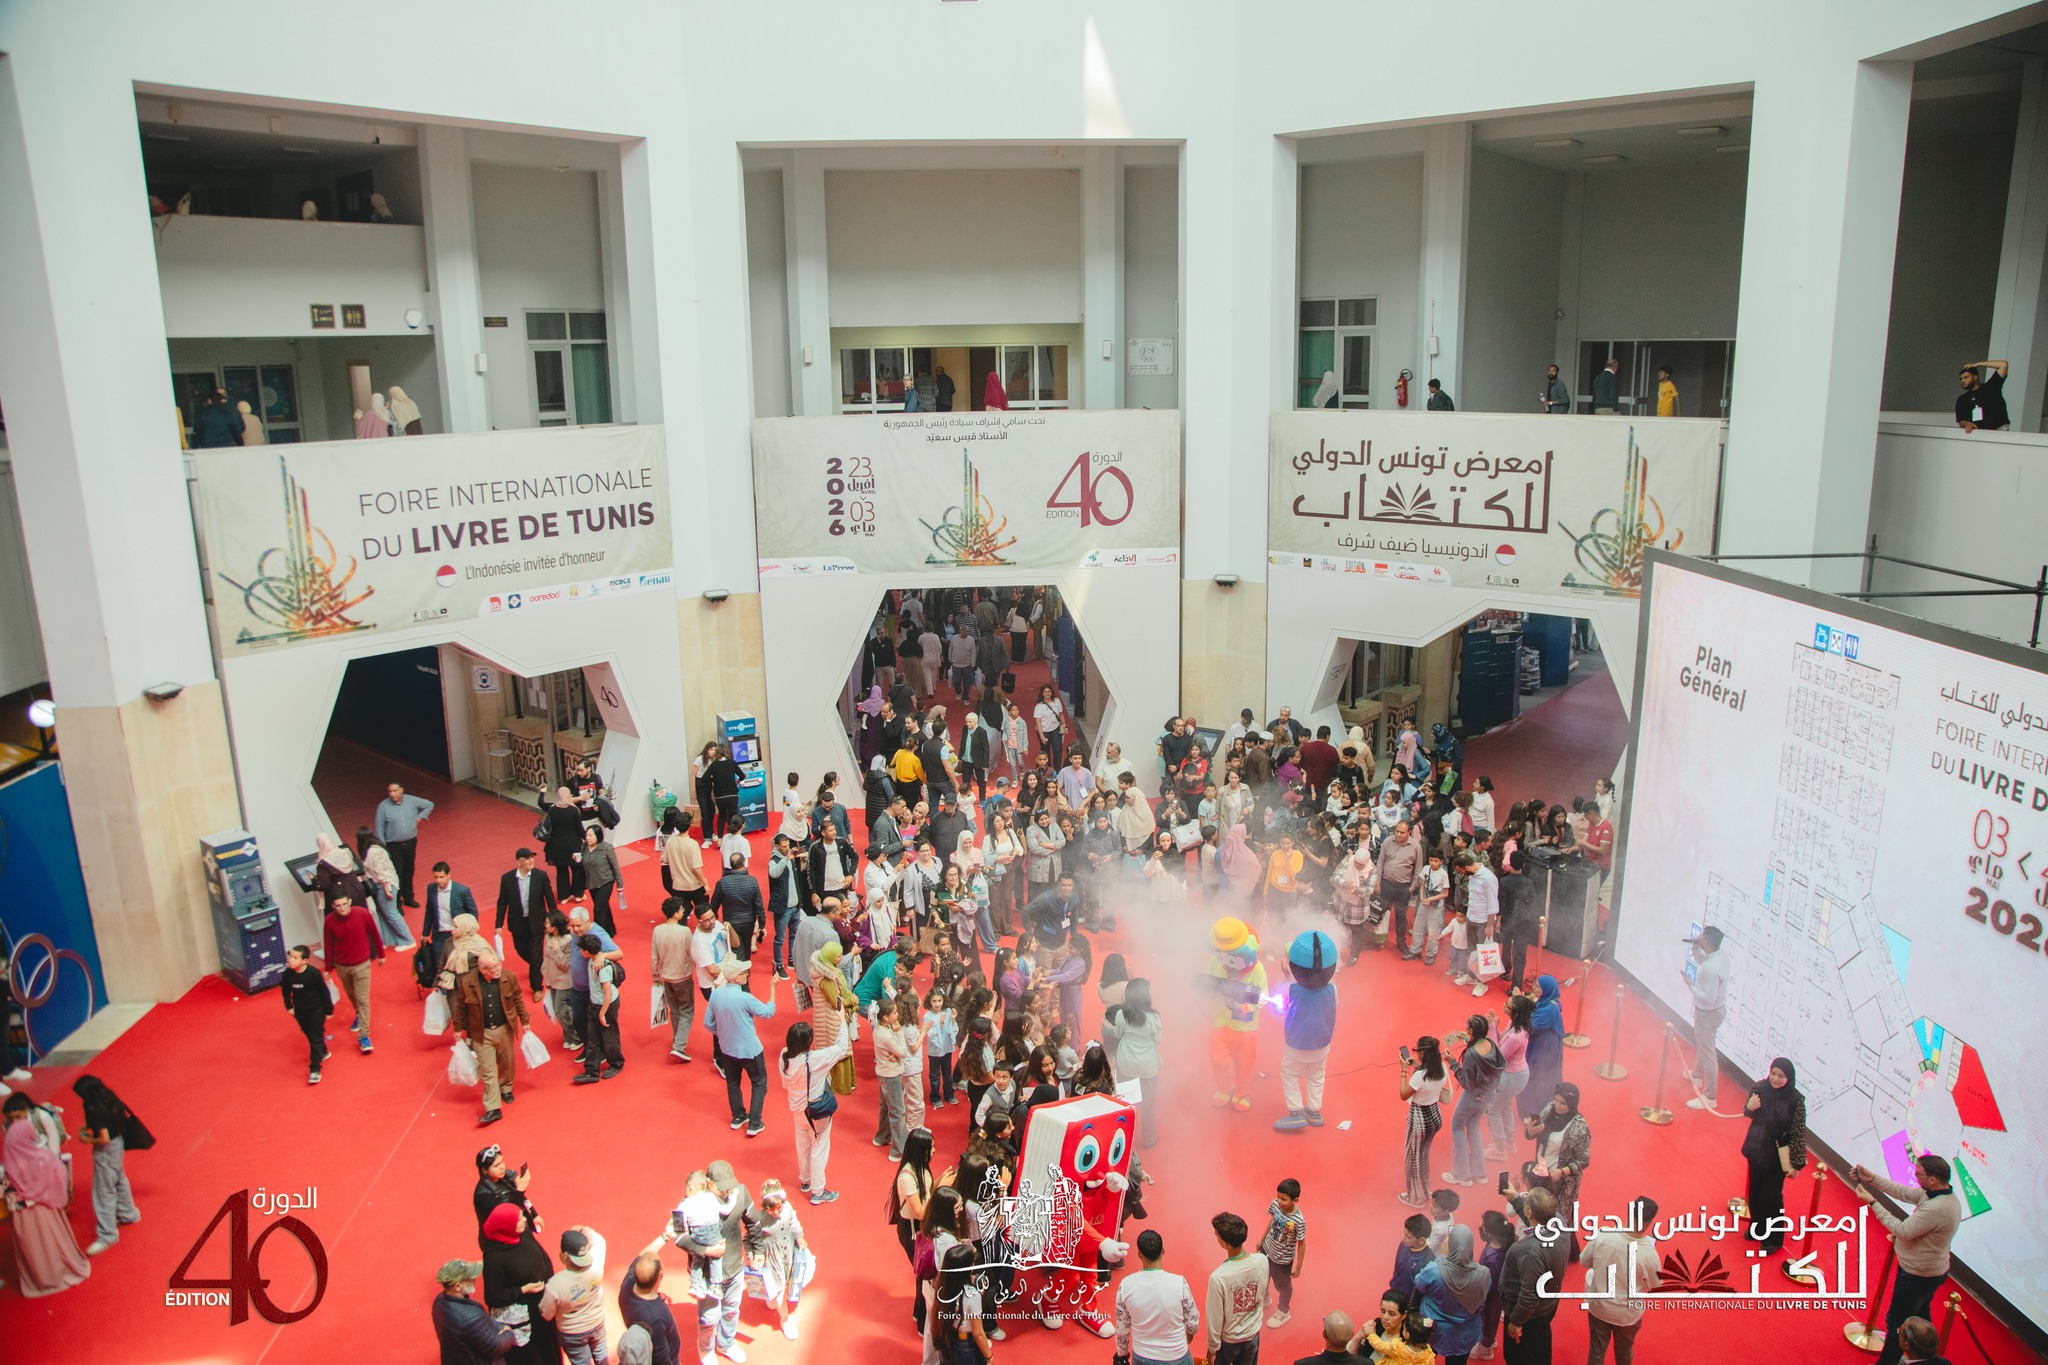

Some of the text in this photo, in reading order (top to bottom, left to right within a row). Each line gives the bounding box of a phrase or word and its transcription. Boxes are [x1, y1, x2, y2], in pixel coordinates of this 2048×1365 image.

[883, 418, 924, 430] الجمهورية
[925, 418, 948, 429] رئيس
[949, 418, 974, 427] سيادة
[975, 417, 1001, 427] إشراف
[1002, 418, 1027, 428] سامي
[953, 433, 977, 443] قيس
[978, 430, 1008, 440] الأستاذ
[848, 456, 873, 478] 23
[1092, 451, 1122, 465] الدورة
[1292, 438, 1543, 479] معرض تونس الدولي
[359, 467, 653, 517] FOIRE INTERNATIONALE
[1046, 451, 1134, 528] 40
[849, 501, 876, 522] 03
[1046, 508, 1080, 519] ÉDITION
[362, 501, 655, 561] DU LIVRE DE TUNIS
[850, 521, 876, 535] ماي
[1337, 533, 1489, 561] اندونيسيا ضيف شرف
[465, 549, 606, 580] L'Indonésie invitée d'honneur
[529, 590, 562, 603] ooredoo
[1695, 645, 1732, 679] Plan
[1680, 665, 1747, 712] Général
[1940, 681, 2048, 732] دولي للكتاب
[1936, 718, 1988, 753] FOIRE
[1931, 751, 1956, 776] DU
[1958, 758, 2026, 805] LIVRE
[1973, 809, 2010, 858] 03
[1986, 877, 2001, 892] MAI
[1964, 886, 2048, 958] 202
